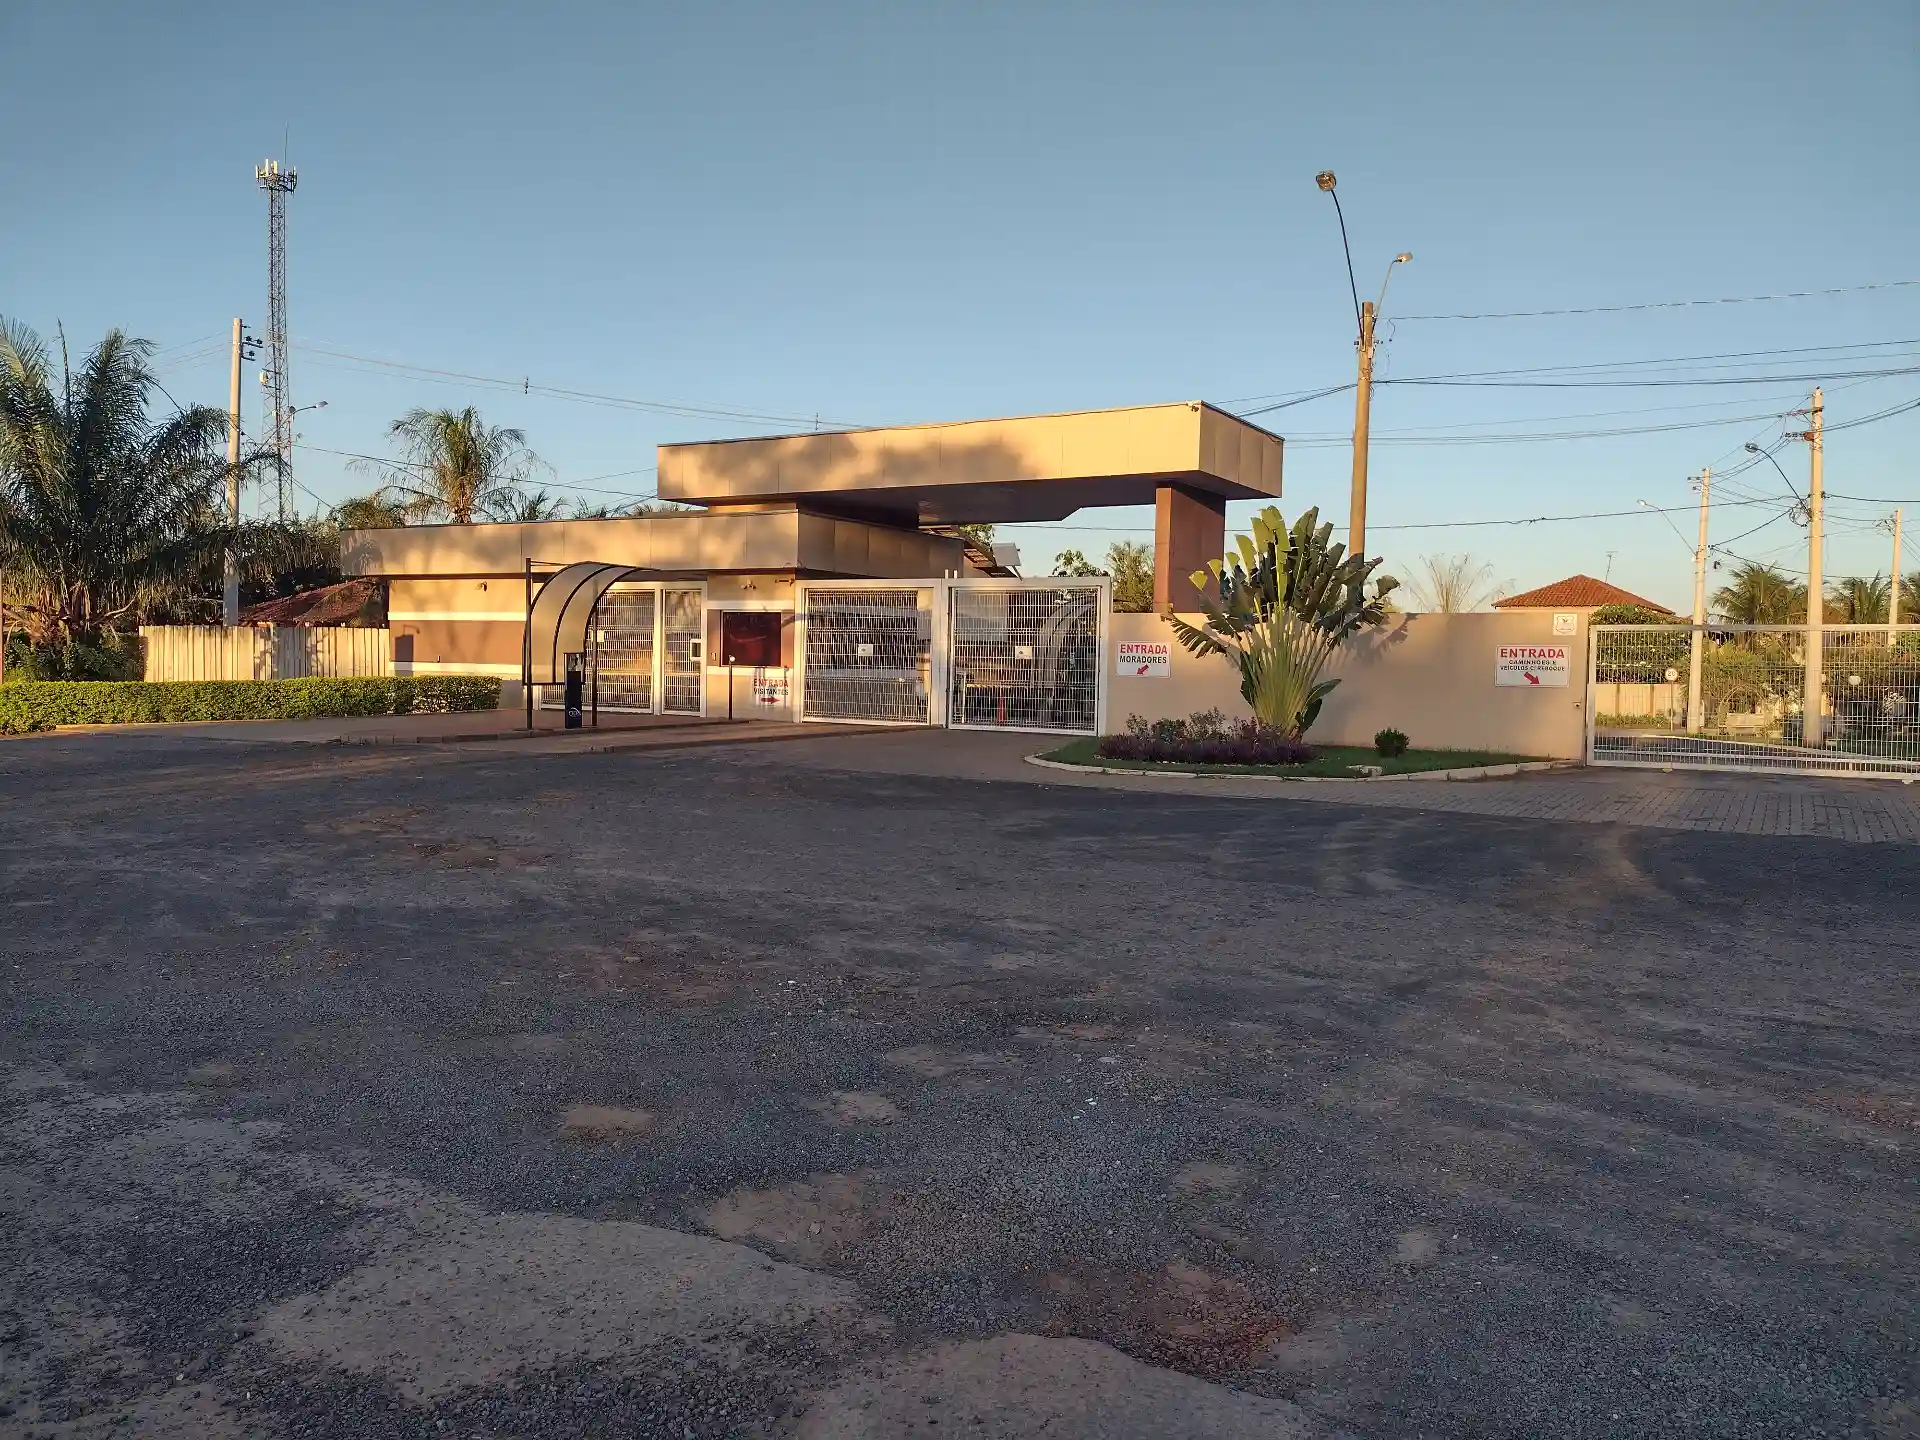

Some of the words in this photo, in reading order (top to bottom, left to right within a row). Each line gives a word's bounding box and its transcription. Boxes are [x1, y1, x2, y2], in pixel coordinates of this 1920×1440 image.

[1120, 644, 1168, 654] ENTRADA
[1500, 648, 1565, 658] ENTRADA
[1119, 655, 1167, 663] MORADORES
[753, 678, 789, 688] ENTRADA
